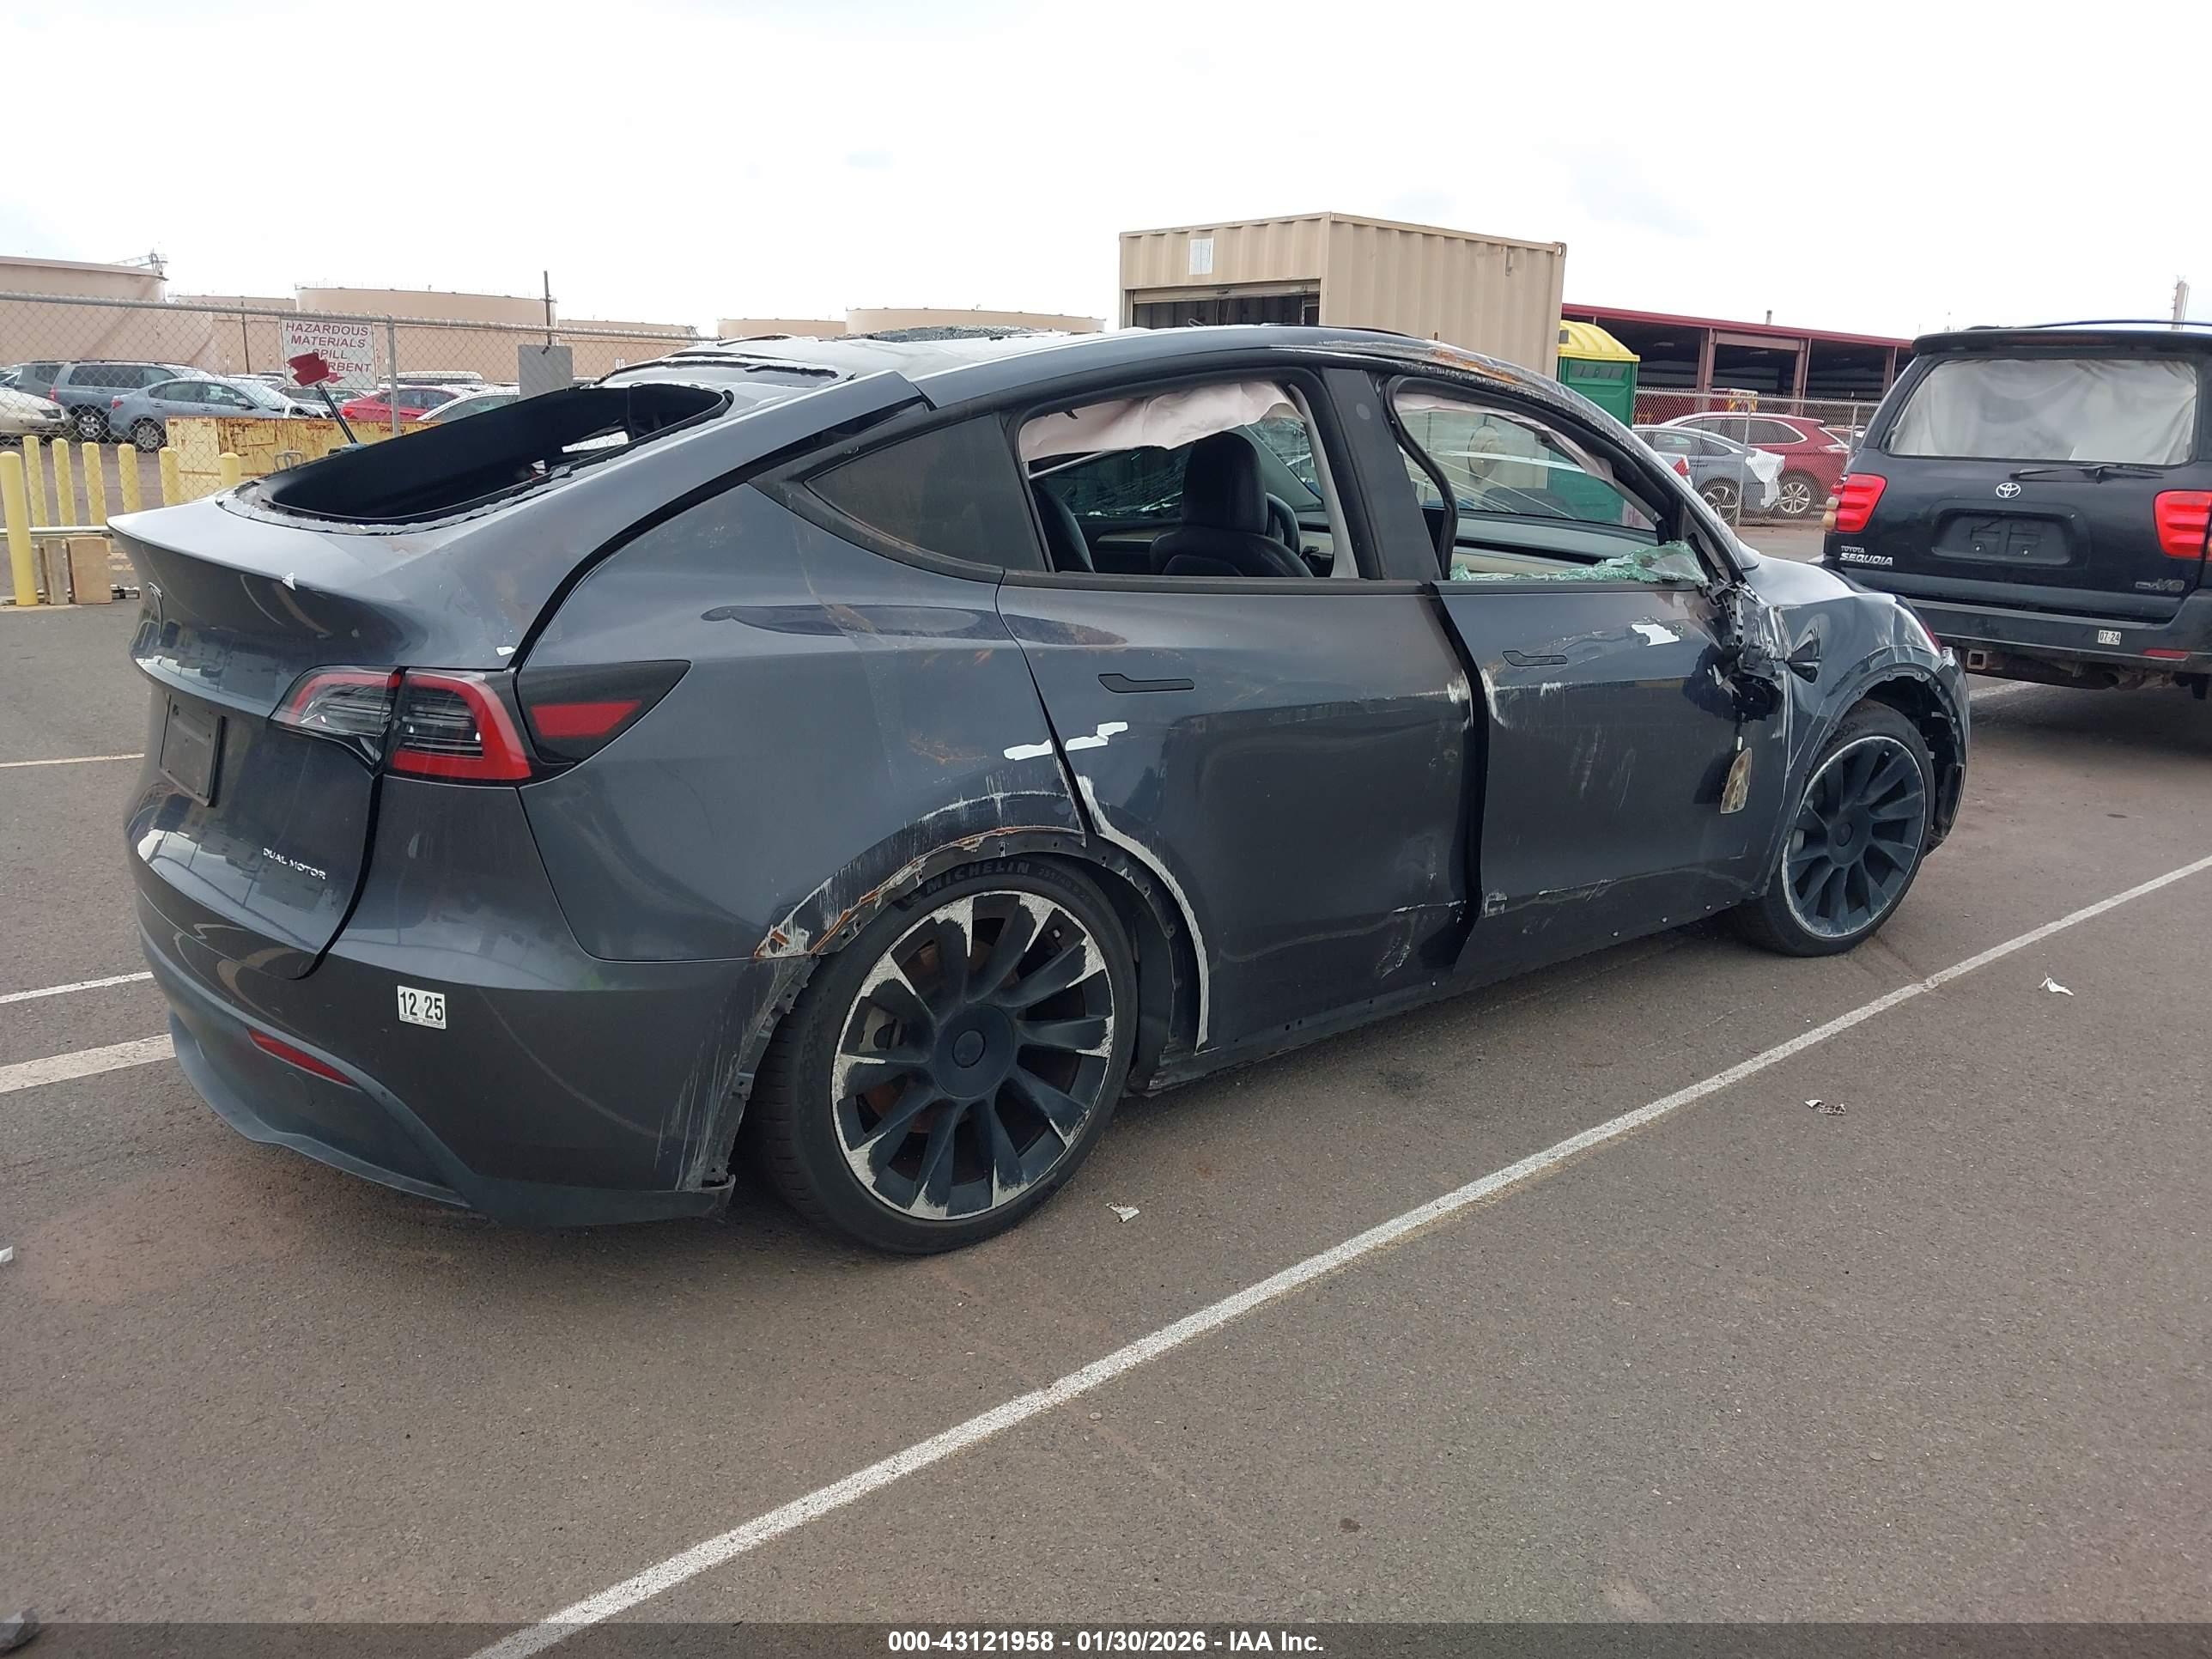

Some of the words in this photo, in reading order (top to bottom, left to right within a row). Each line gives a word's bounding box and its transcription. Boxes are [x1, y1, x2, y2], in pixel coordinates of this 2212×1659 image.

[286, 322, 368, 336] HAZARDOUS
[291, 335, 365, 348] MATERIALS
[328, 362, 371, 373] RBENT
[1839, 552, 1893, 566] SEQUOIA
[263, 848, 288, 865] DUAL
[927, 860, 1030, 895] MICHELIN
